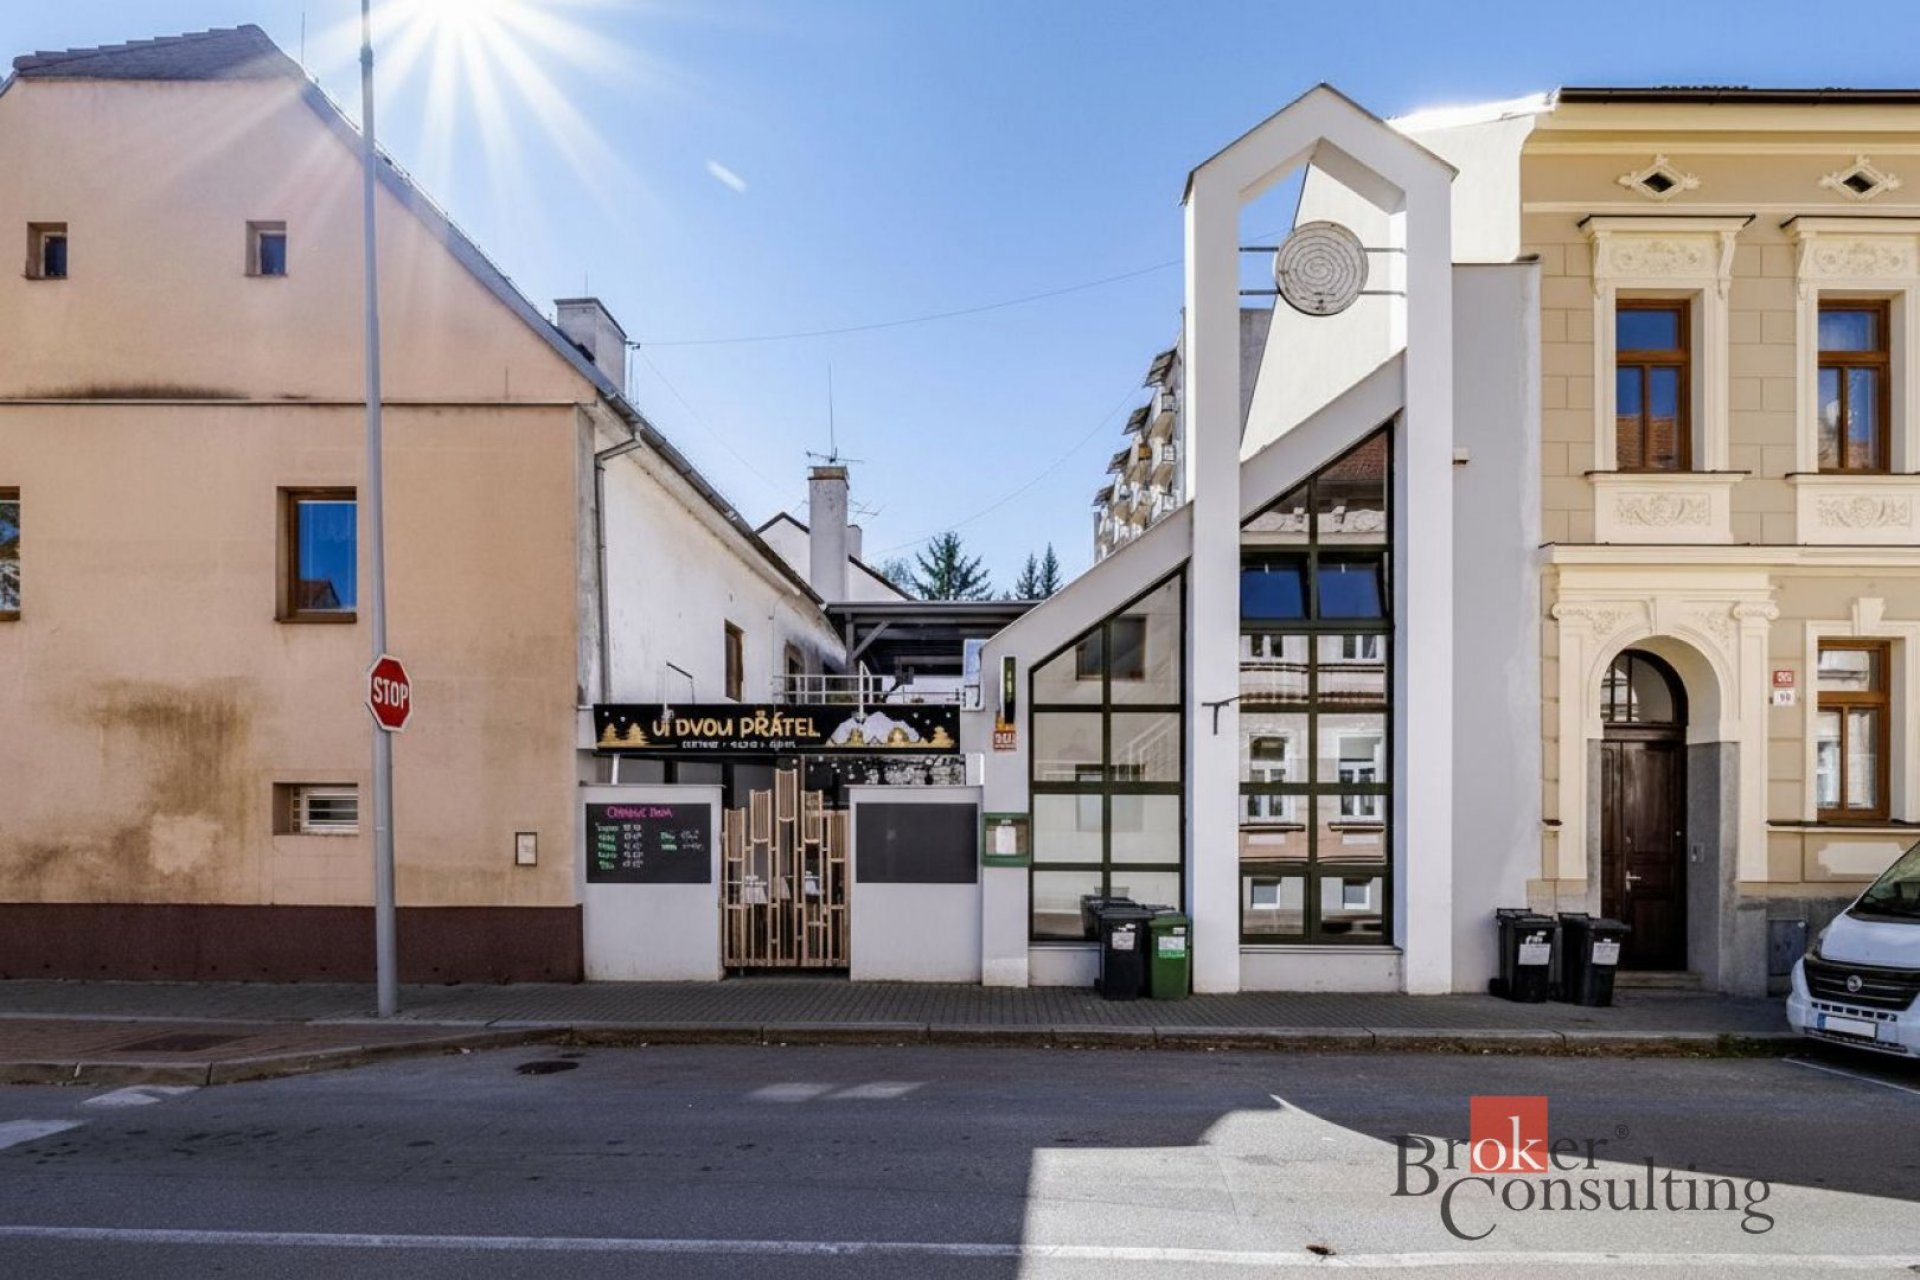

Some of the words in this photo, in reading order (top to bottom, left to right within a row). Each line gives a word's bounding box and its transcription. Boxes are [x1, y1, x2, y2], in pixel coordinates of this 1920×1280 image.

[373, 676, 409, 710] STOP
[675, 717, 733, 737] DVOU
[740, 710, 821, 738] PŘÁTEL
